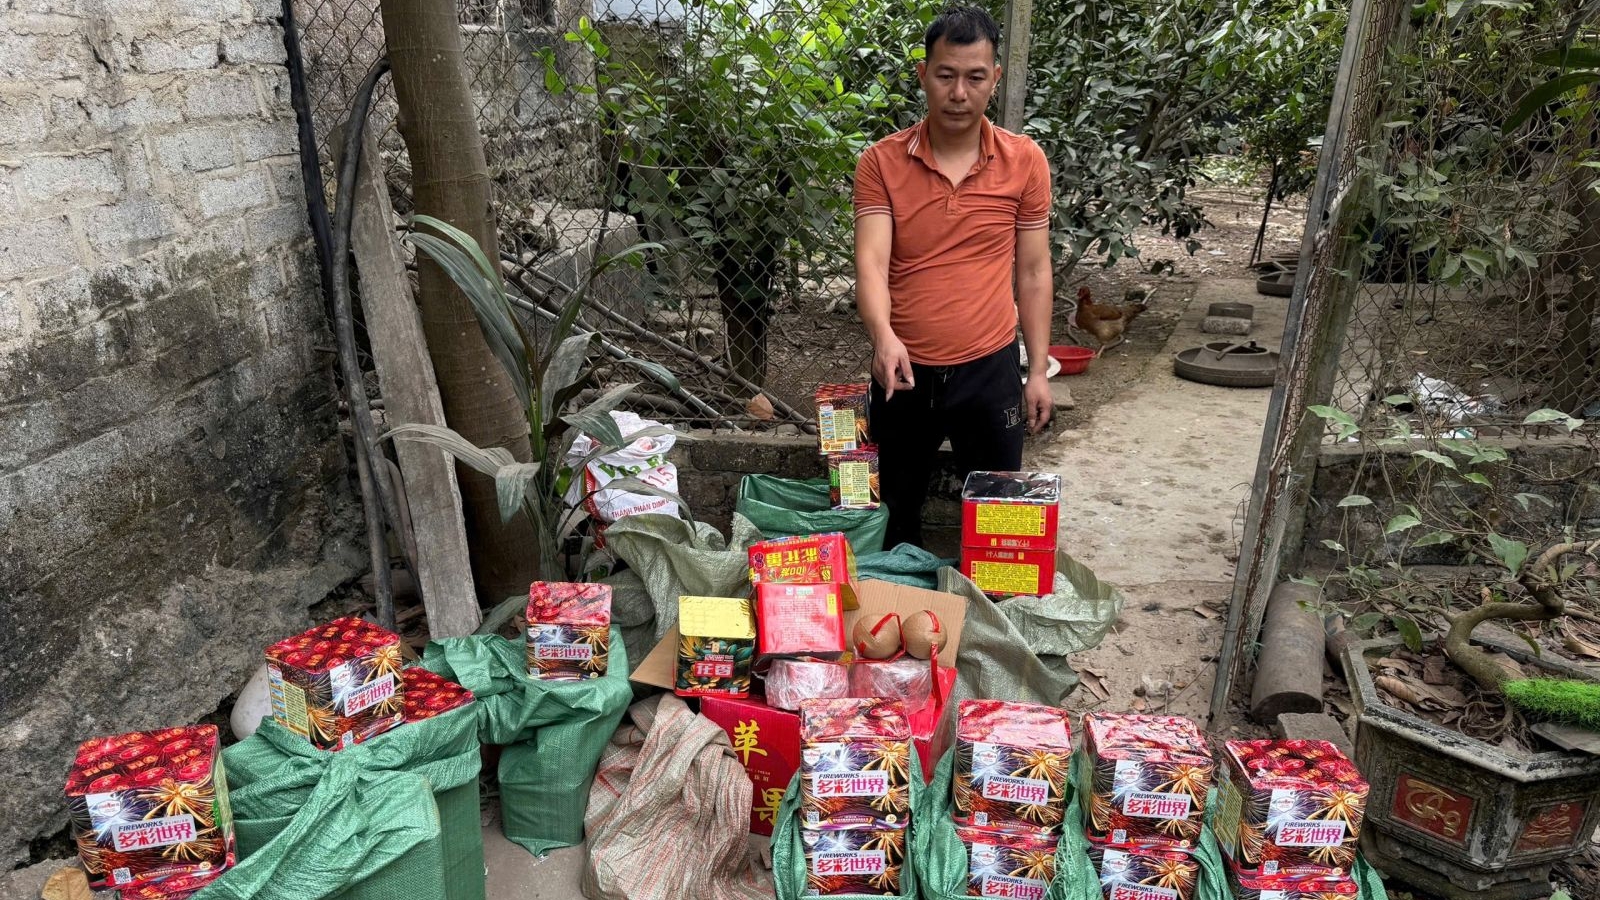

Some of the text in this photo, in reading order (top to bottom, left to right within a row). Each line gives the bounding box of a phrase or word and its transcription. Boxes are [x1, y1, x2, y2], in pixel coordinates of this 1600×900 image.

[538, 647, 590, 659] 多彩世界
[346, 680, 393, 713] 多彩世界
[817, 778, 884, 795] 多彩世界
[989, 775, 1025, 785] FIREWORKS
[986, 781, 1046, 803] 多彩世界
[1130, 792, 1167, 800] FIREWORKS
[1126, 799, 1187, 817] 多彩世界
[118, 819, 164, 832] FIREWORKS
[118, 822, 193, 849] 多彩世界
[1279, 827, 1342, 844] 多彩世界
[816, 857, 882, 873] 多彩世界
[987, 875, 1023, 885] FIREWORKS
[1117, 882, 1154, 892] FIREWORKS
[985, 880, 1044, 900] 多彩世界
